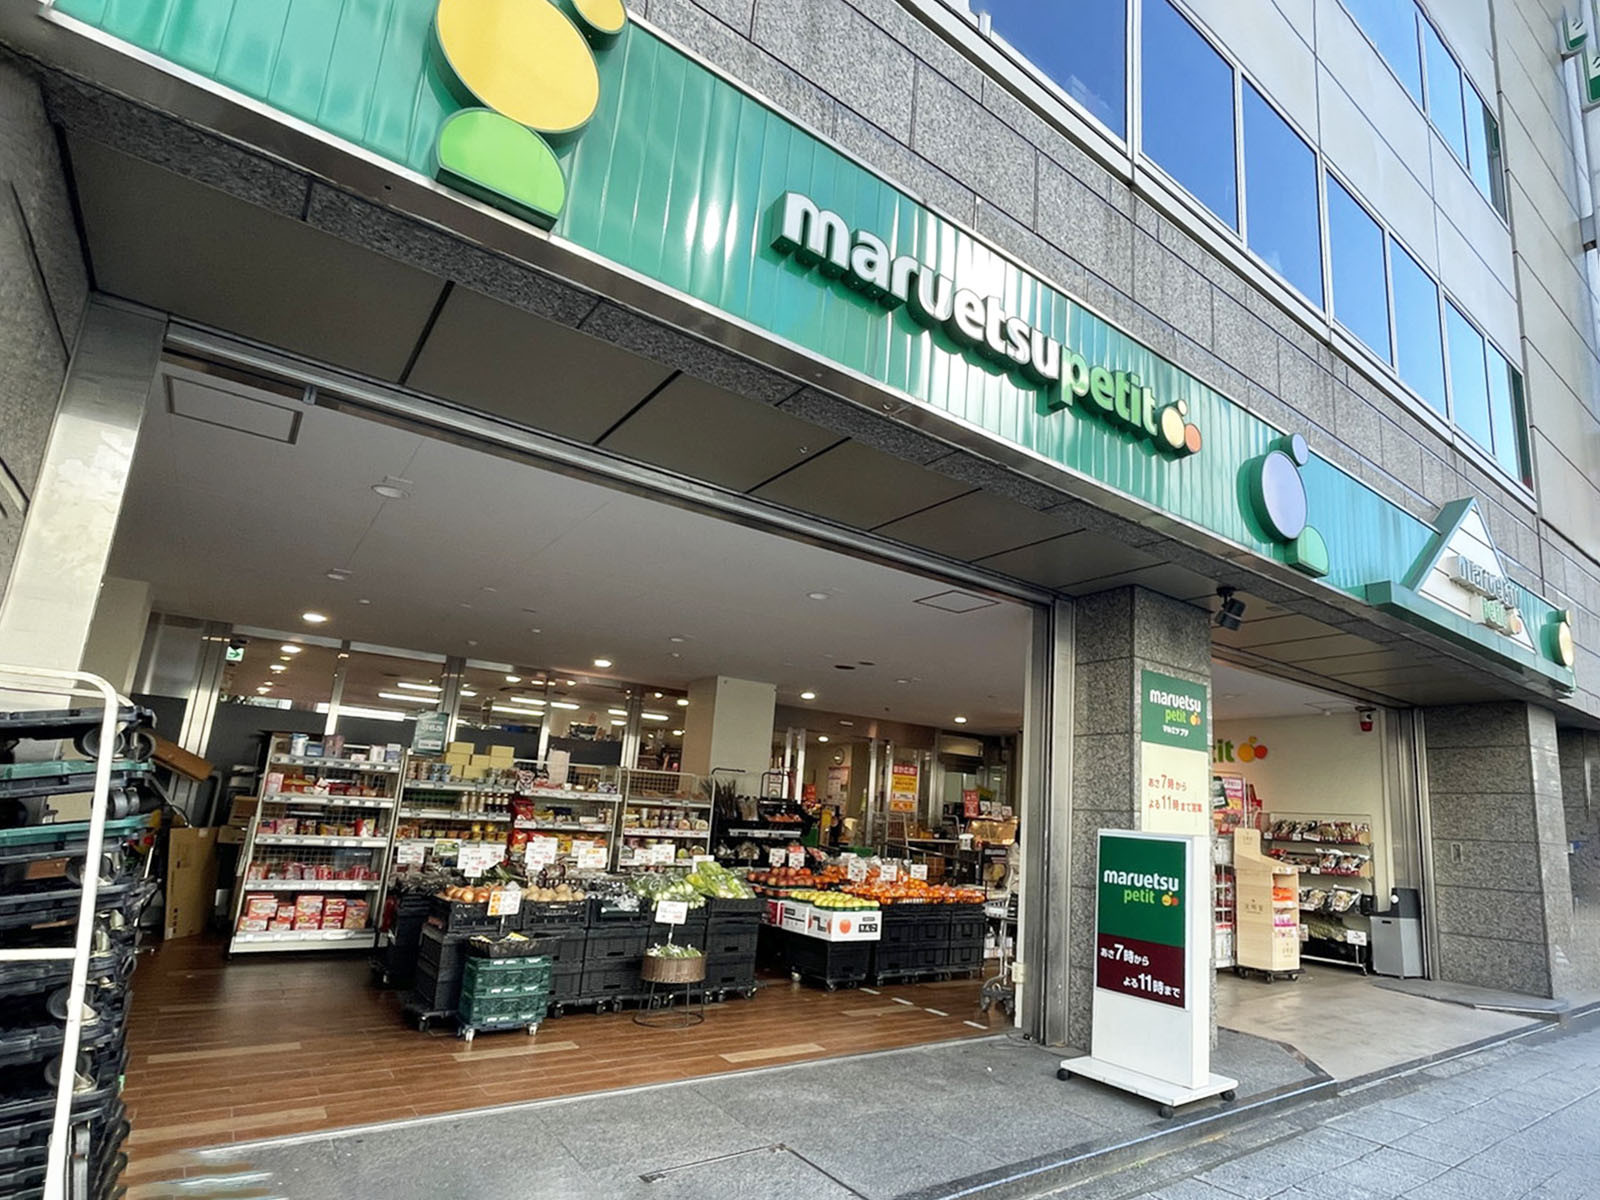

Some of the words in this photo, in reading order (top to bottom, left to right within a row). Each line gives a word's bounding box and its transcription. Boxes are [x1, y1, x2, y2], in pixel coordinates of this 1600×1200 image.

[784, 191, 1062, 380] maruetsu
[1061, 344, 1158, 435] petit
[1149, 688, 1202, 713] maruetsu
[1164, 708, 1187, 724] petit
[1103, 869, 1179, 891] maruetsu
[1123, 889, 1156, 904] petit
[1100, 943, 1150, 967] あさ7時から
[1123, 973, 1181, 998] よる11時まで
